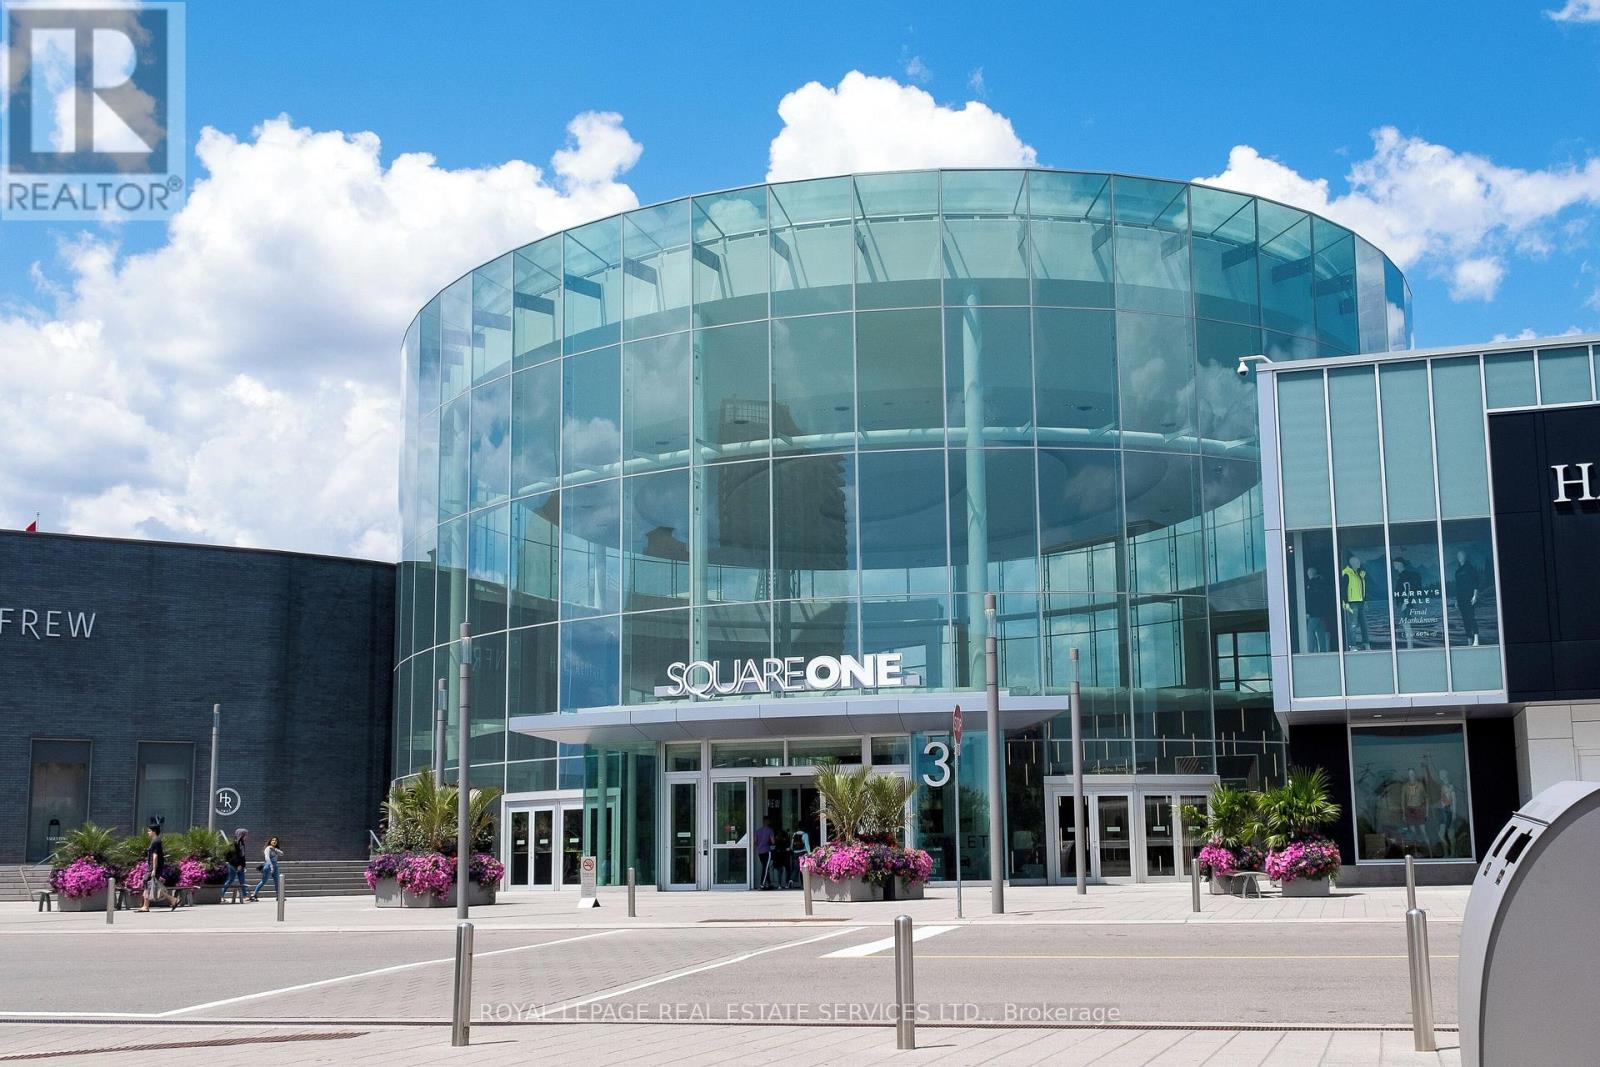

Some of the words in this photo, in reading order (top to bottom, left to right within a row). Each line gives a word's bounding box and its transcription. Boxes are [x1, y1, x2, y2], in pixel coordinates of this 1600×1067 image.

[1550, 462, 1600, 503] H
[1394, 589, 1440, 597] HARRY'S
[0, 607, 96, 640] FREW
[922, 741, 951, 788] 3
